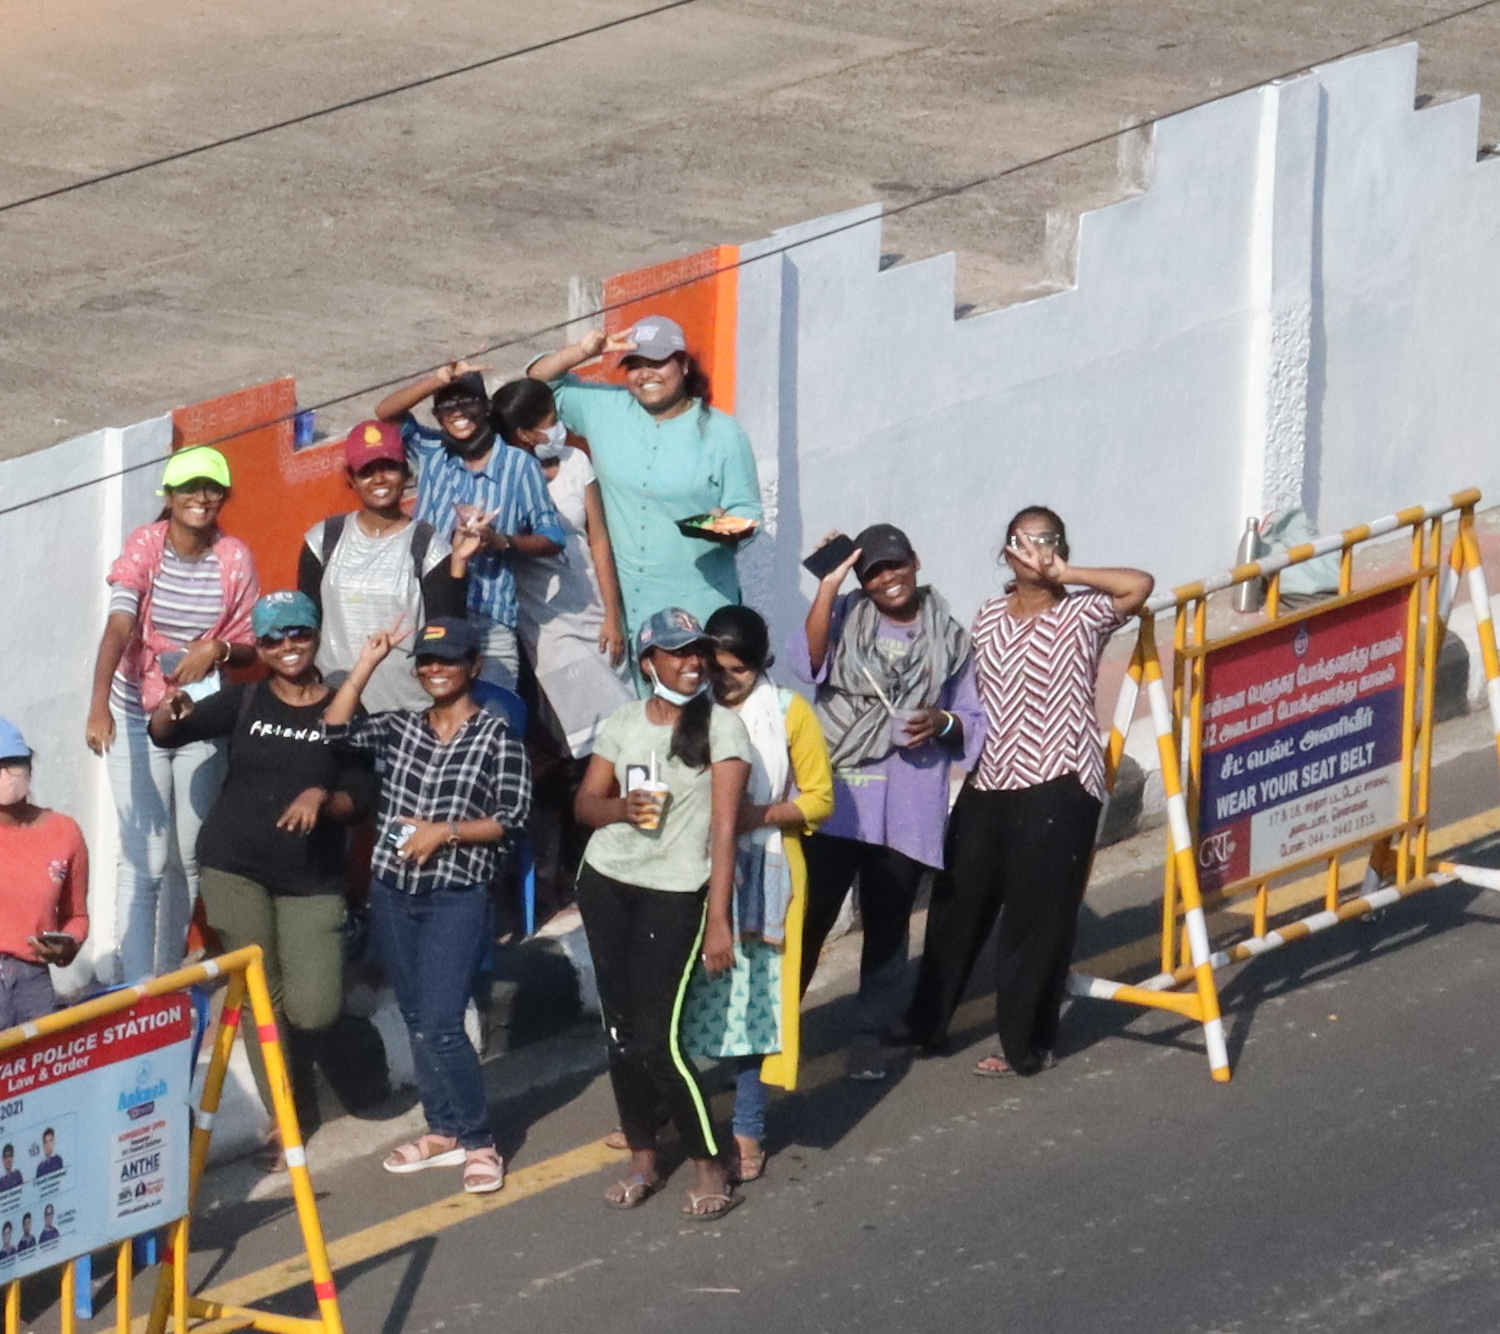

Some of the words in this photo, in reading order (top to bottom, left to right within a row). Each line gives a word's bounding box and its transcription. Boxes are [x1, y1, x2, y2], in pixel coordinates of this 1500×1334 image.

[250, 720, 329, 745] FRIEND
[1216, 785, 1257, 819] WEAR
[1260, 770, 1298, 803] YOUR
[1302, 754, 1338, 788] SEAT
[1340, 741, 1376, 775] BELT
[31, 1032, 98, 1069] POLICE
[102, 1006, 182, 1045] STATION
[7, 1072, 35, 1093] Law
[39, 1067, 49, 1082] &
[52, 1055, 91, 1076] Order
[0, 1100, 23, 1120] 2021
[120, 1152, 160, 1180] ANTHE
